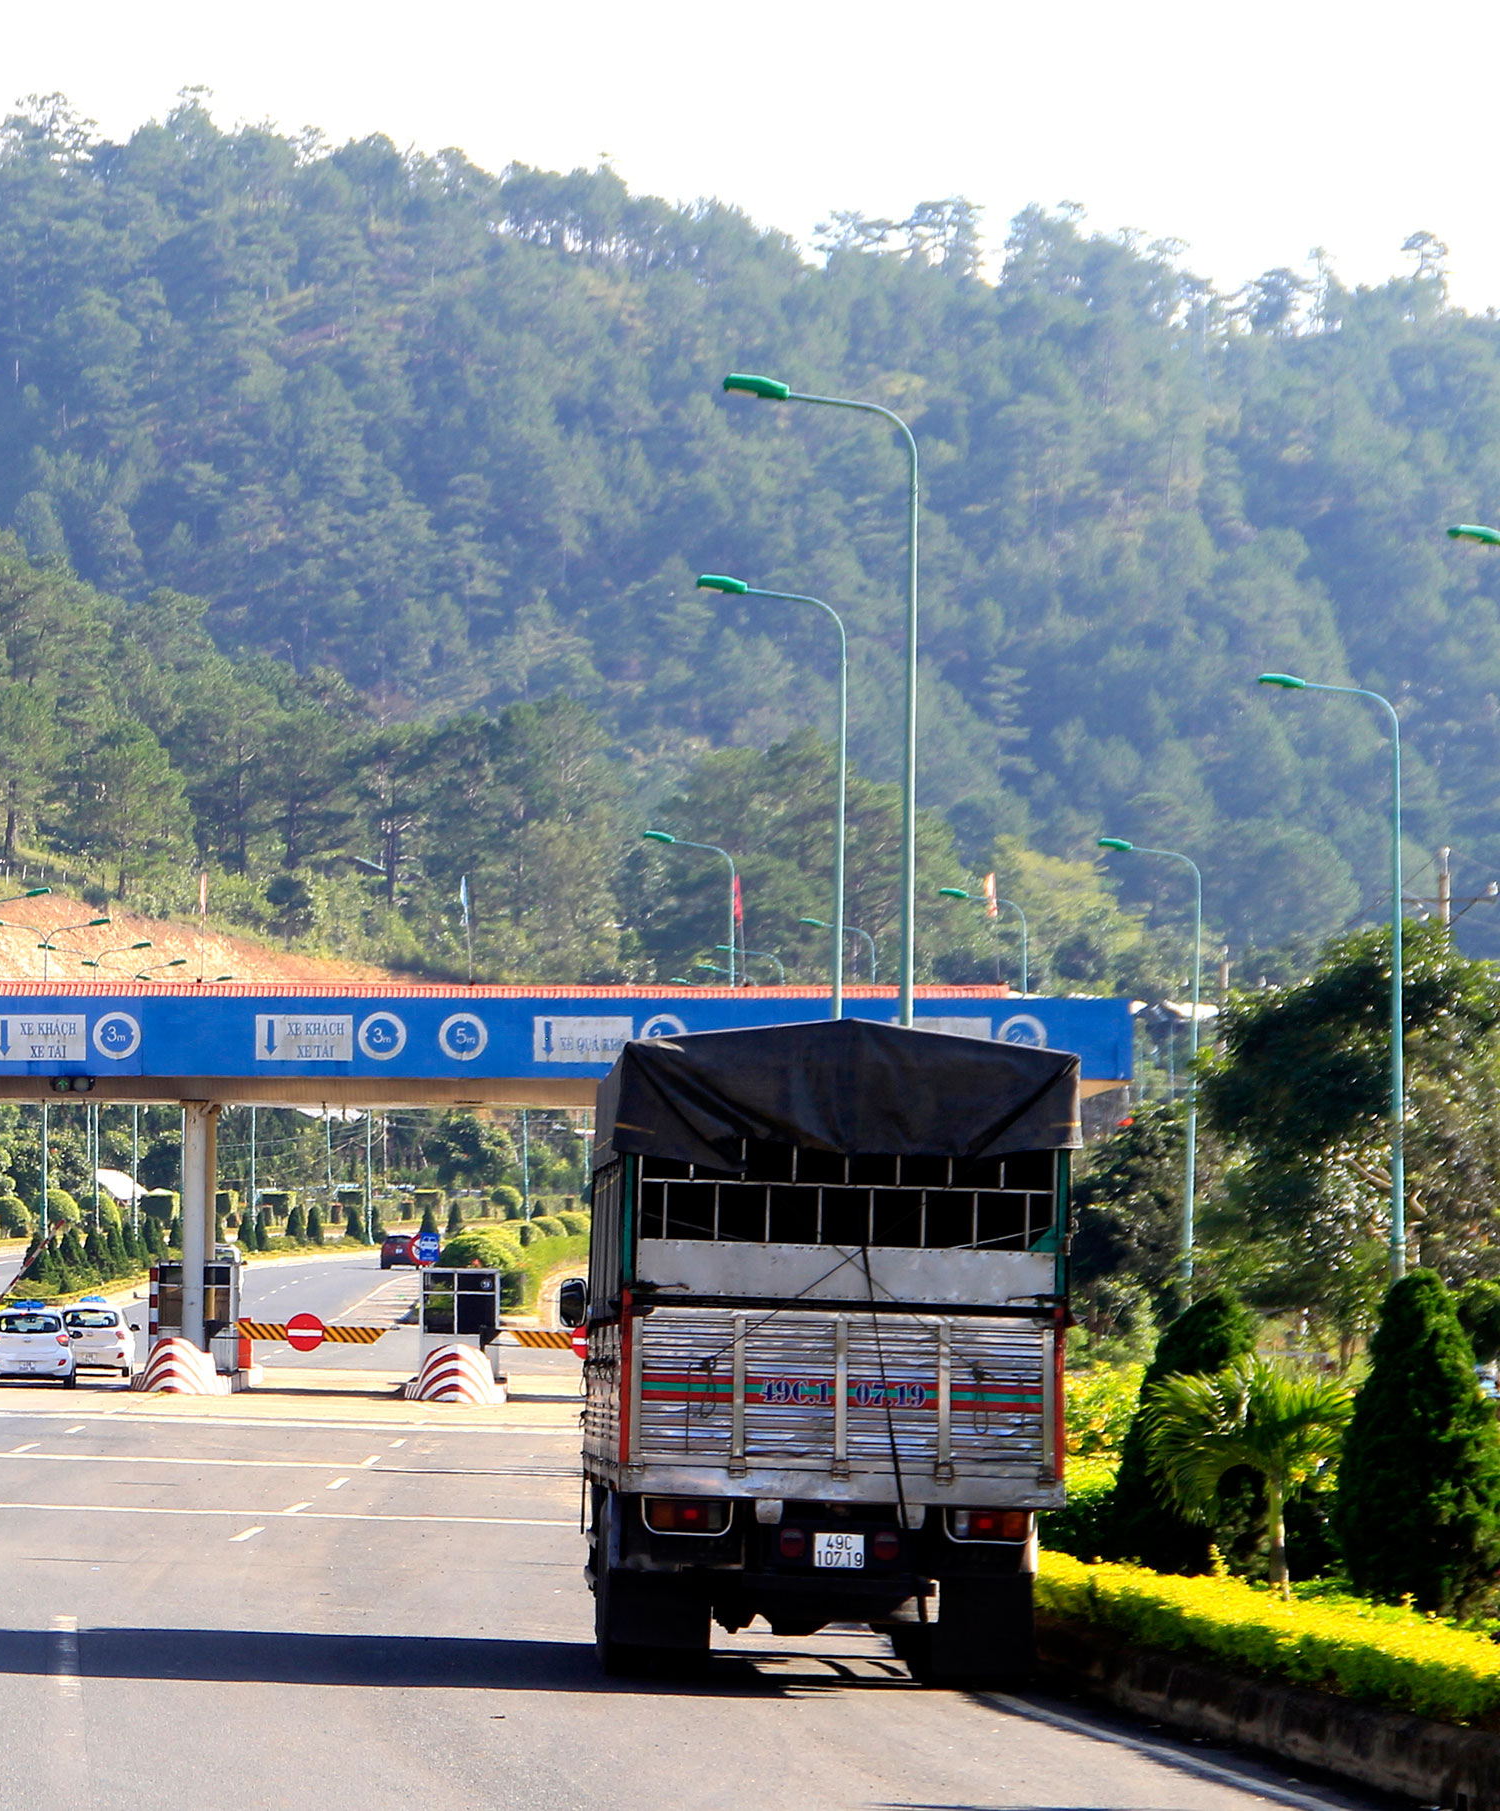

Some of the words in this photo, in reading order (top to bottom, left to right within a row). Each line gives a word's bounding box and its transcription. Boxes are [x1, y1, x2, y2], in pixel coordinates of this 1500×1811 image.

[20, 1022, 34, 1036] XE
[38, 1018, 77, 1036] KHÁCH
[287, 1022, 302, 1036] XE
[305, 1019, 344, 1036] KHÁCH
[31, 1045, 45, 1058] XE
[48, 1040, 67, 1059] TẢI
[297, 1045, 312, 1058] XE
[314, 1041, 334, 1059] TẢI
[759, 1378, 831, 1405] 49C.1
[827, 1535, 853, 1550] 49C
[817, 1550, 863, 1567] 107.19
